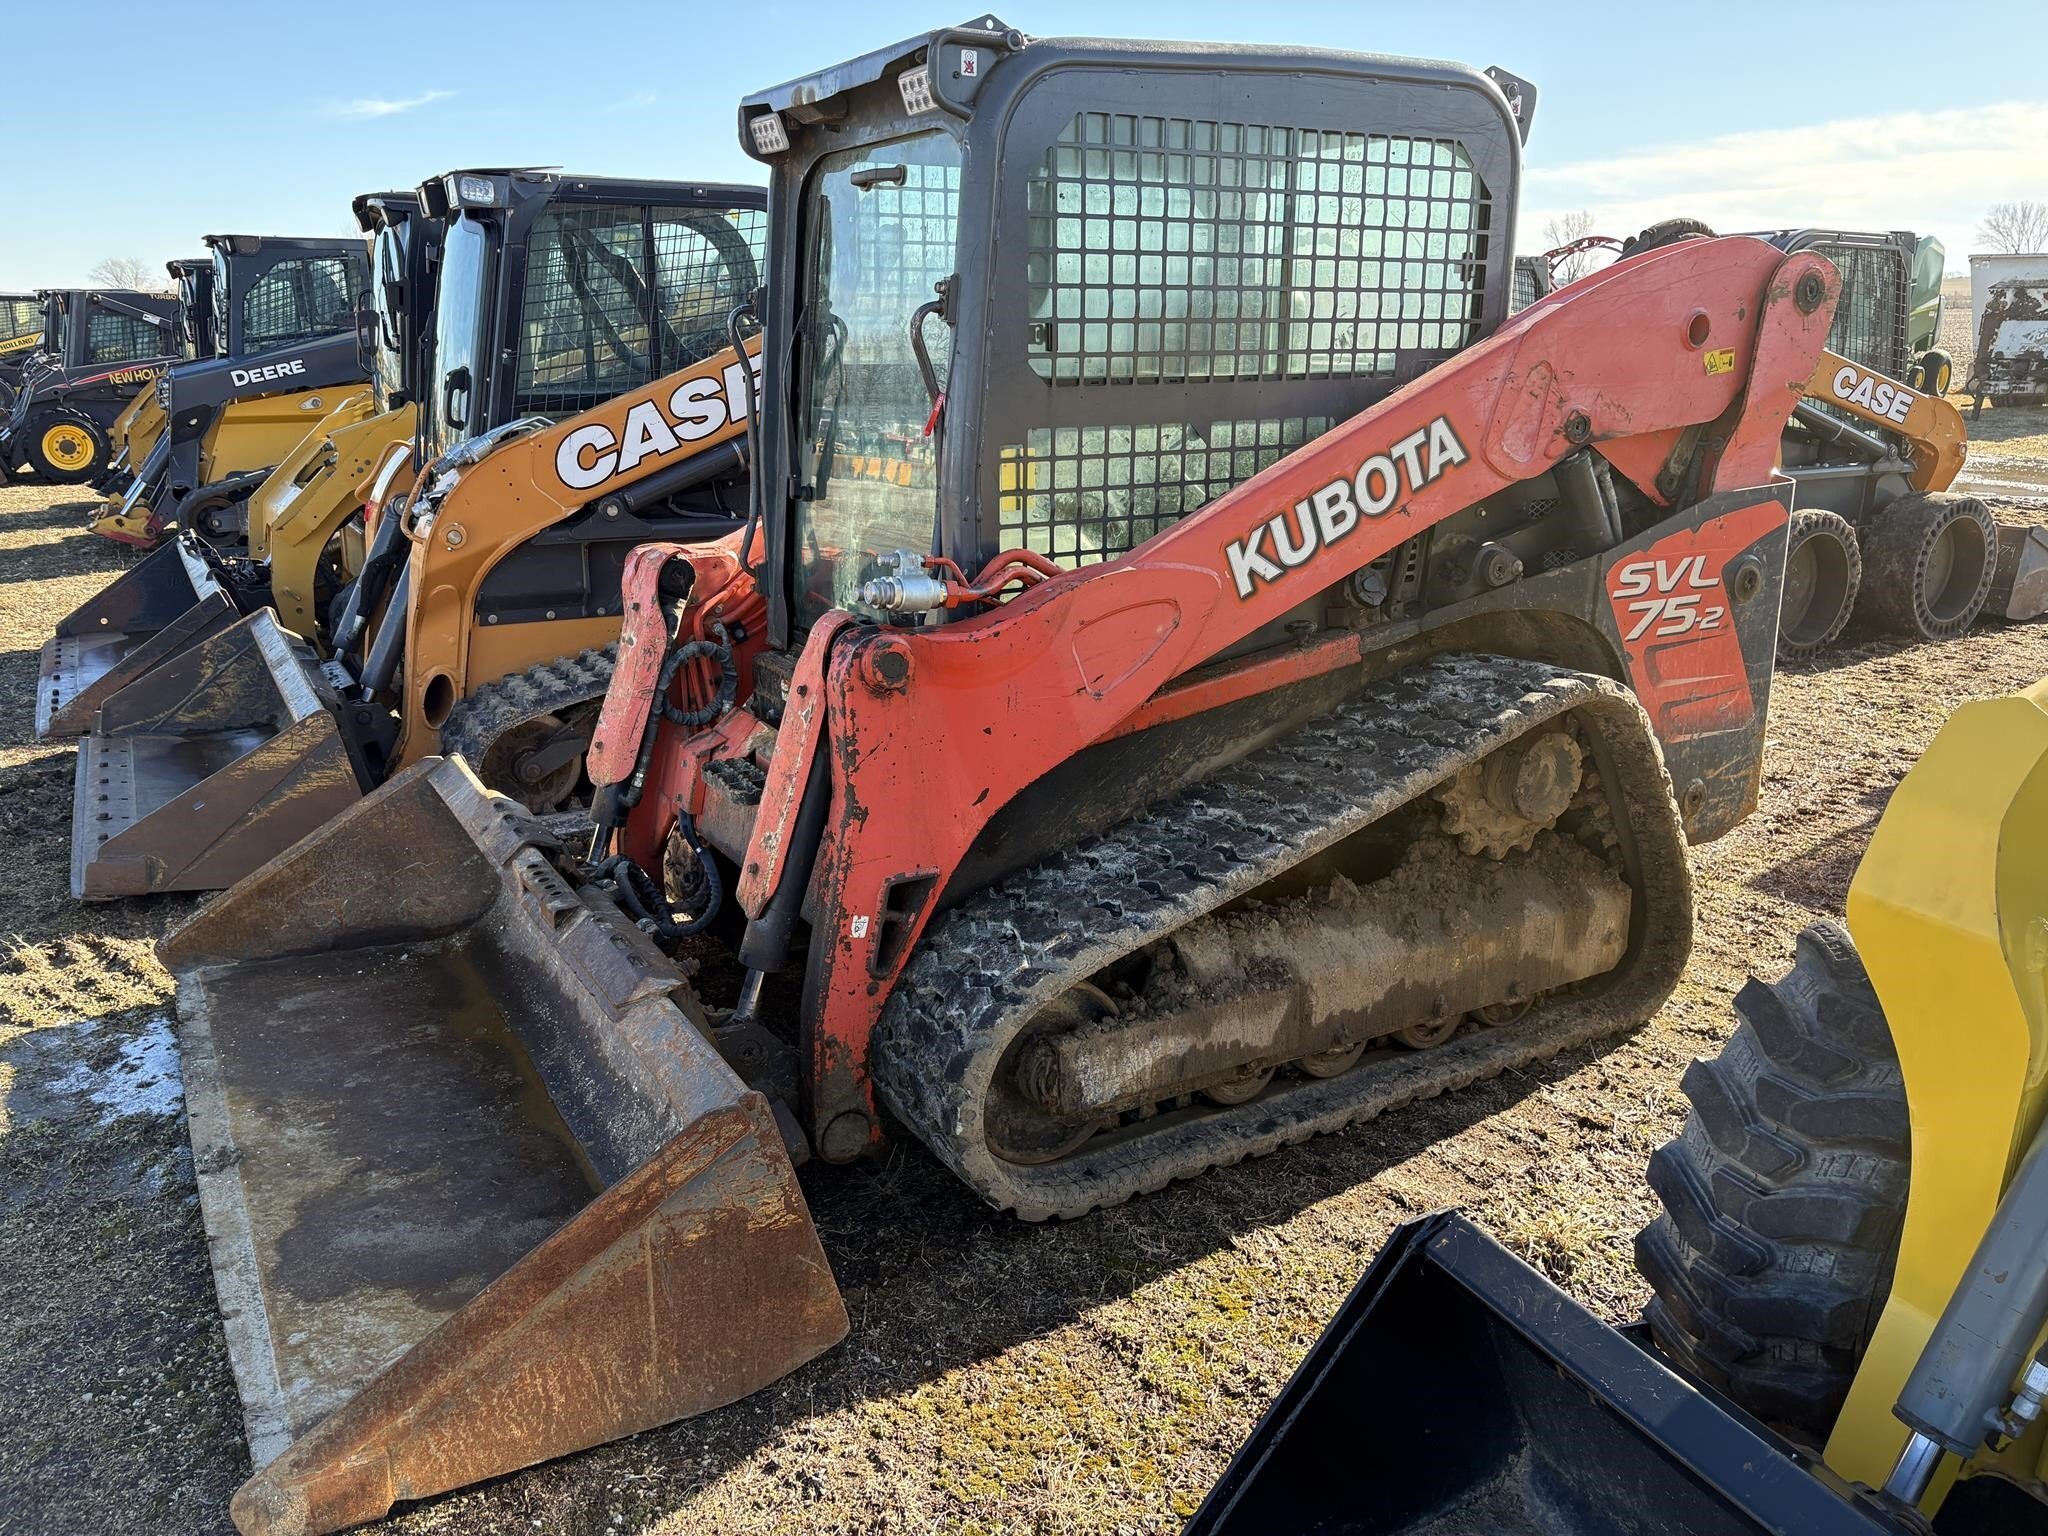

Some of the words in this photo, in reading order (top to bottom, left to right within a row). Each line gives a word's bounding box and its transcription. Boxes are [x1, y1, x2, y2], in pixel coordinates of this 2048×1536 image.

[109, 370, 133, 385] NEW
[230, 359, 306, 387] DEERE
[1832, 366, 1916, 425] CASE
[1225, 416, 1468, 600] KUBOTA
[1612, 555, 1720, 600] SVL
[1624, 594, 1725, 642] 75-2
